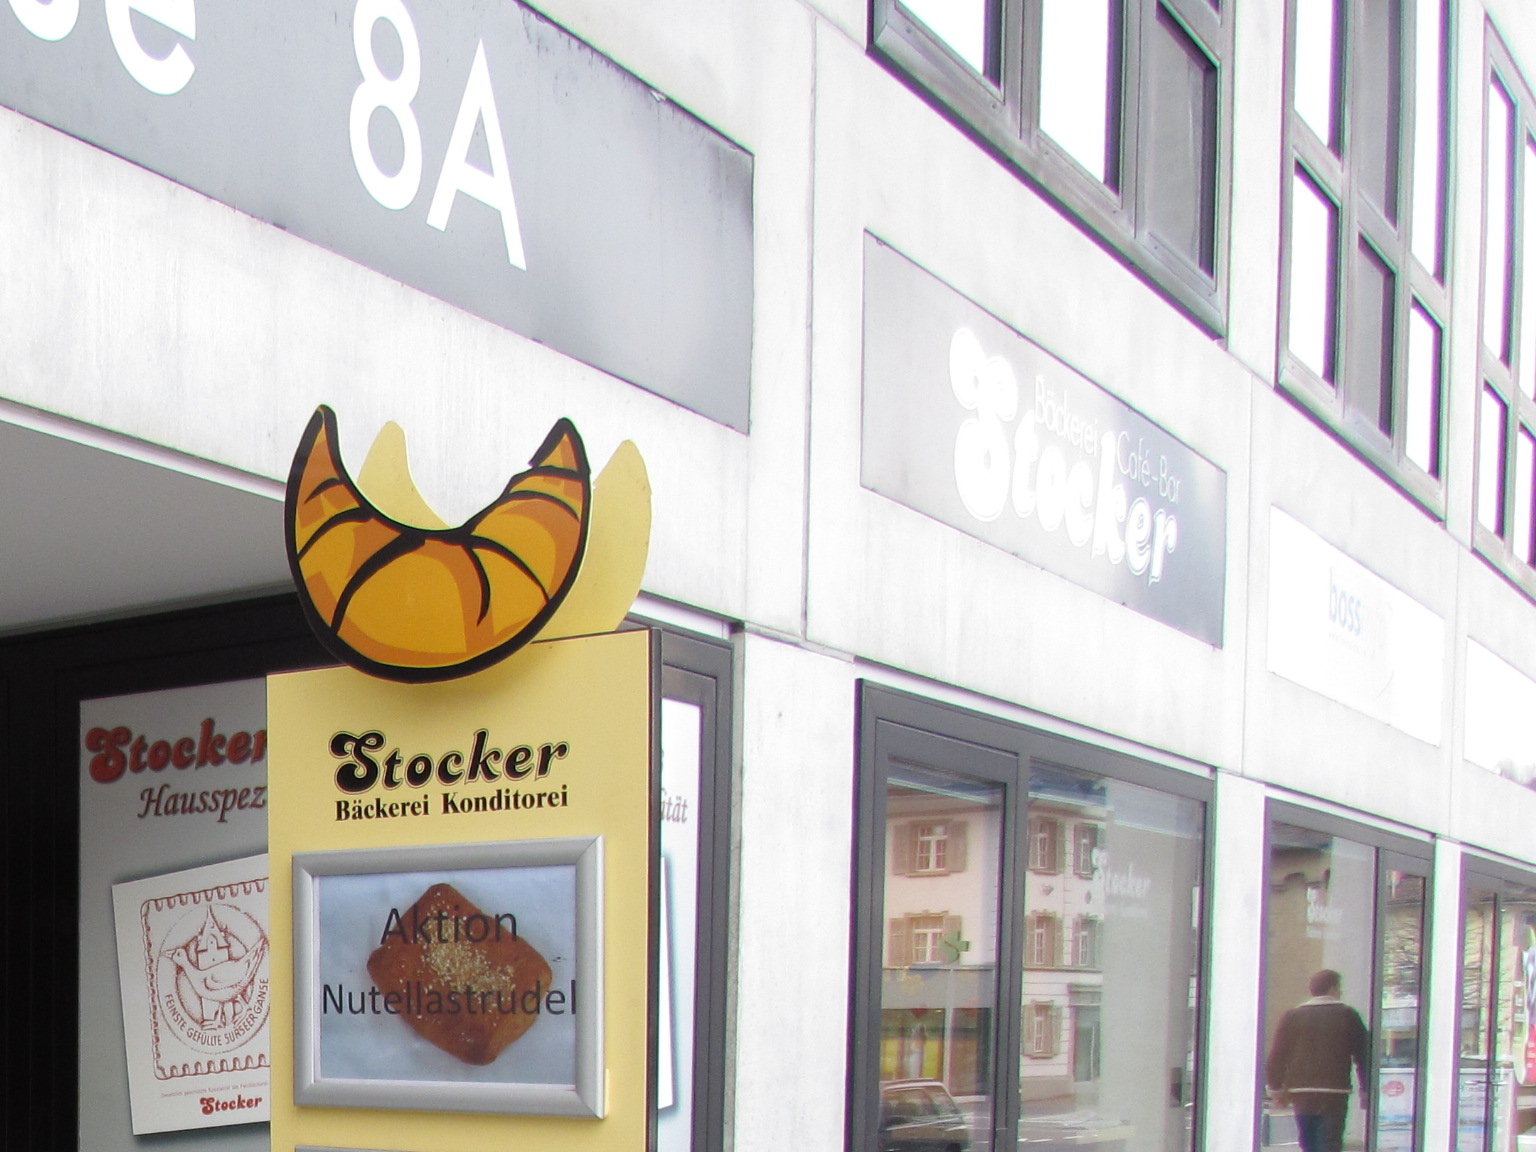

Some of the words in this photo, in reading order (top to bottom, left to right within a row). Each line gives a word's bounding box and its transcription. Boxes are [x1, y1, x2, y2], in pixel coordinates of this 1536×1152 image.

[349, 0, 526, 271] 8A
[1035, 374, 1098, 457] Bäckerei
[949, 326, 1178, 586] Stocker
[85, 717, 268, 784] Stocker
[328, 727, 570, 796] Stocker
[335, 794, 430, 822] Bäckerei
[441, 784, 569, 815] Konditorei
[380, 904, 519, 946] Aktion
[164, 993, 187, 1032] FEINSTE
[322, 979, 577, 1017] Nutellastrudel
[199, 1094, 263, 1116] Stocker
